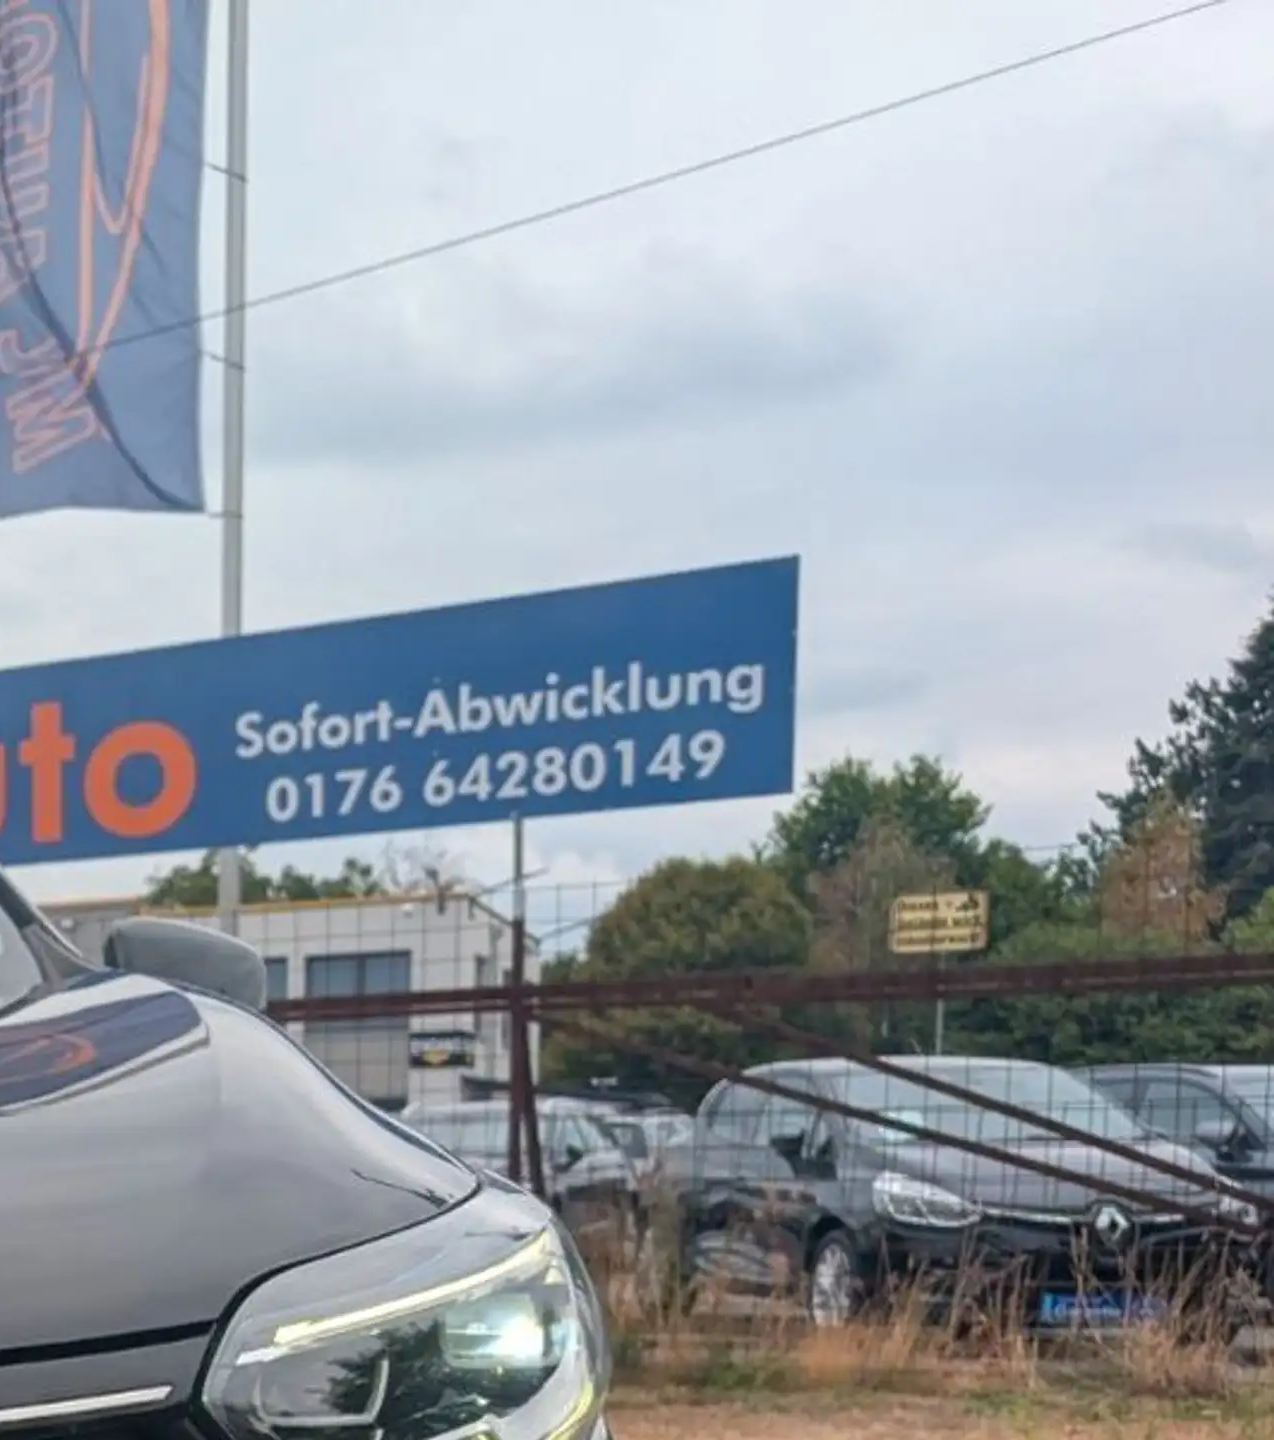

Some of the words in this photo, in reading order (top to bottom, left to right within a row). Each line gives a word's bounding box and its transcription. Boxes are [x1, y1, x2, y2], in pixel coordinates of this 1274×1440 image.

[234, 660, 766, 759] Sofort-Abwicklung
[265, 763, 404, 823] 0176
[422, 728, 726, 808] 64280149
